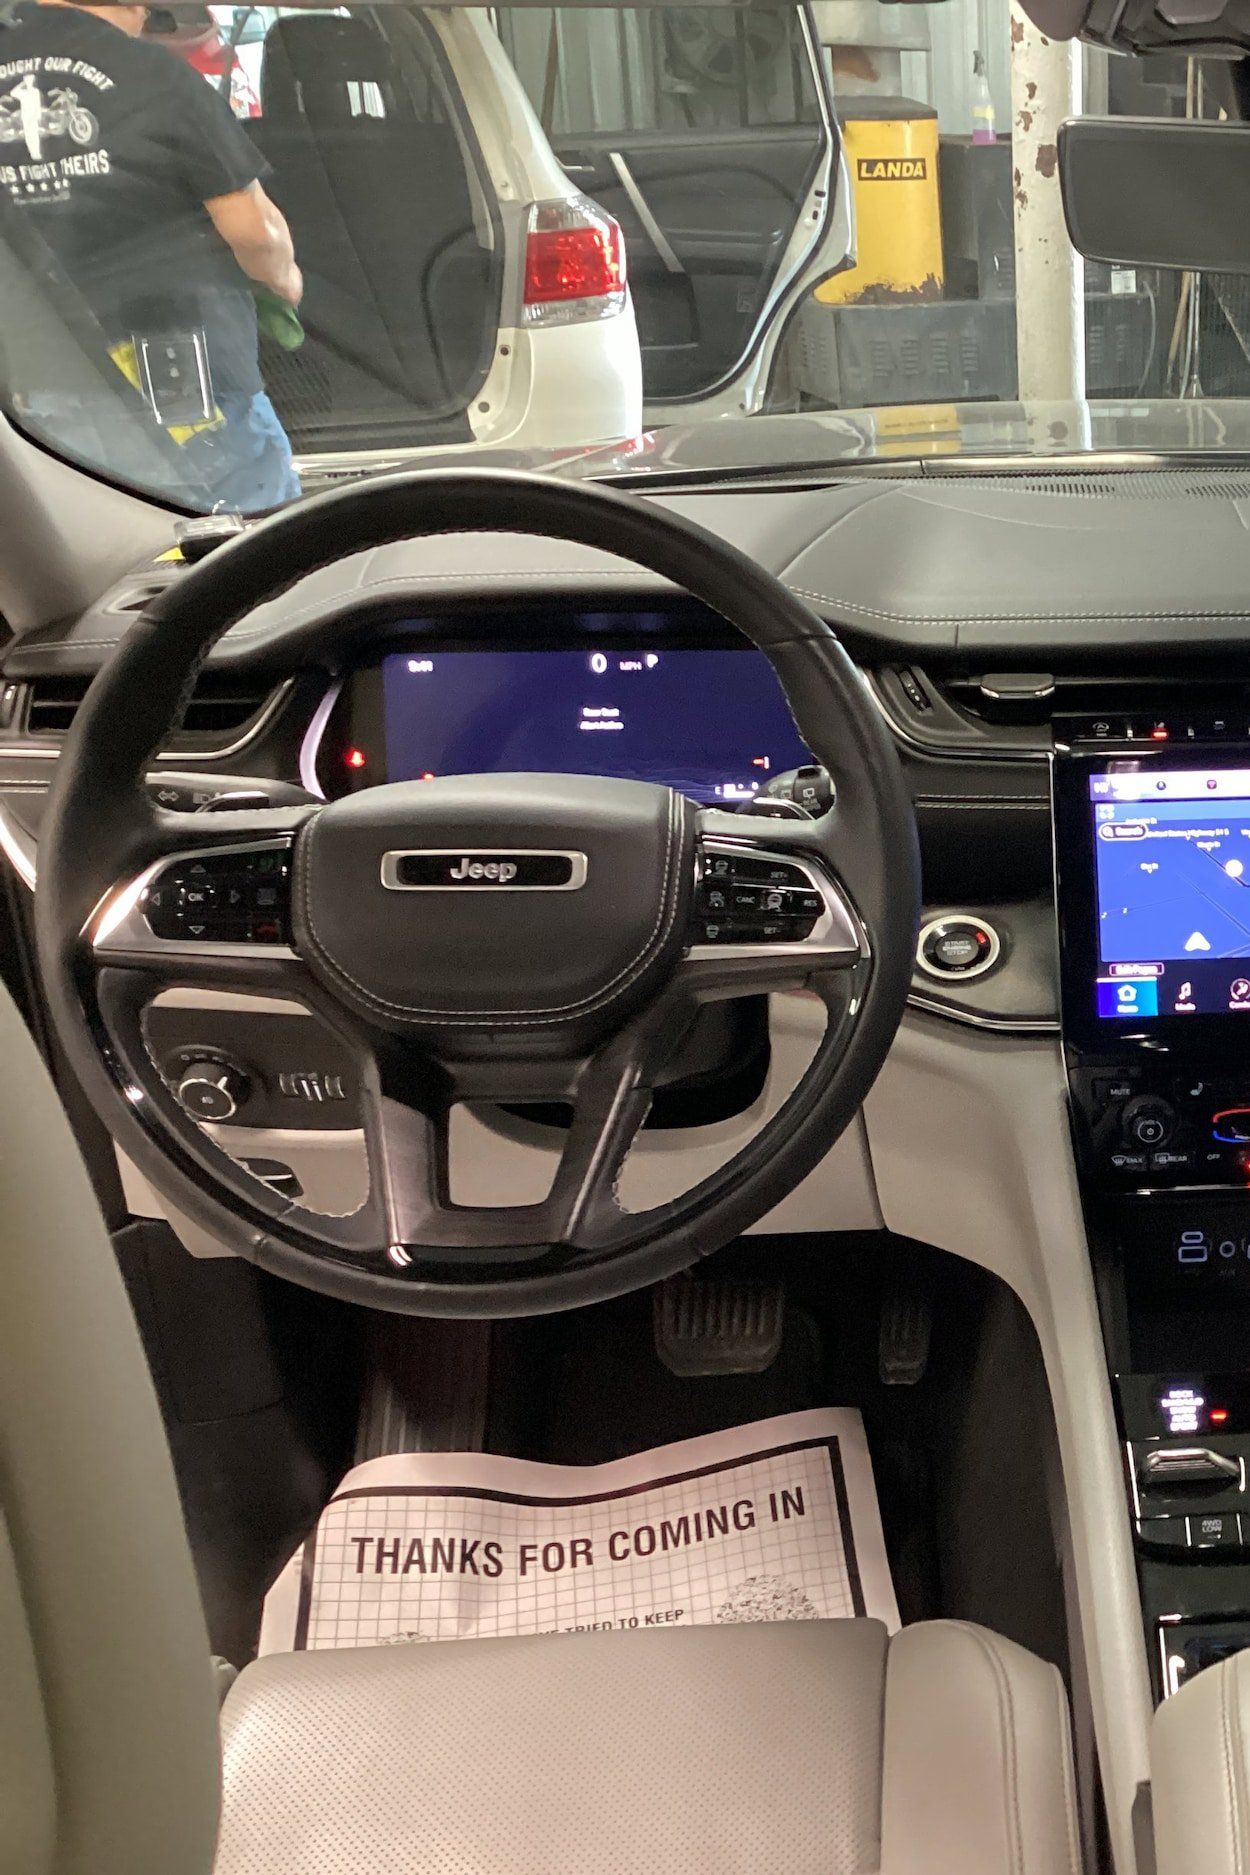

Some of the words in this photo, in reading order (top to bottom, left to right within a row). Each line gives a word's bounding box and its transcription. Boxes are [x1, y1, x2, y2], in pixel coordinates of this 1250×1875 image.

[0, 57, 41, 79] OUGHT
[44, 56, 72, 72] OUR
[72, 60, 114, 90] FIGHT
[19, 162, 57, 181] FIGHT
[860, 161, 924, 178] LANDA
[591, 653, 607, 673] 0
[450, 858, 517, 882] Jeep
[188, 893, 204, 901] OK
[351, 1537, 503, 1578] THANKS
[520, 1538, 593, 1576] FOR
[608, 1500, 755, 1561] COMING
[769, 1486, 805, 1522] IN
[618, 1616, 639, 1629] TO
[645, 1609, 684, 1625] KEEP
